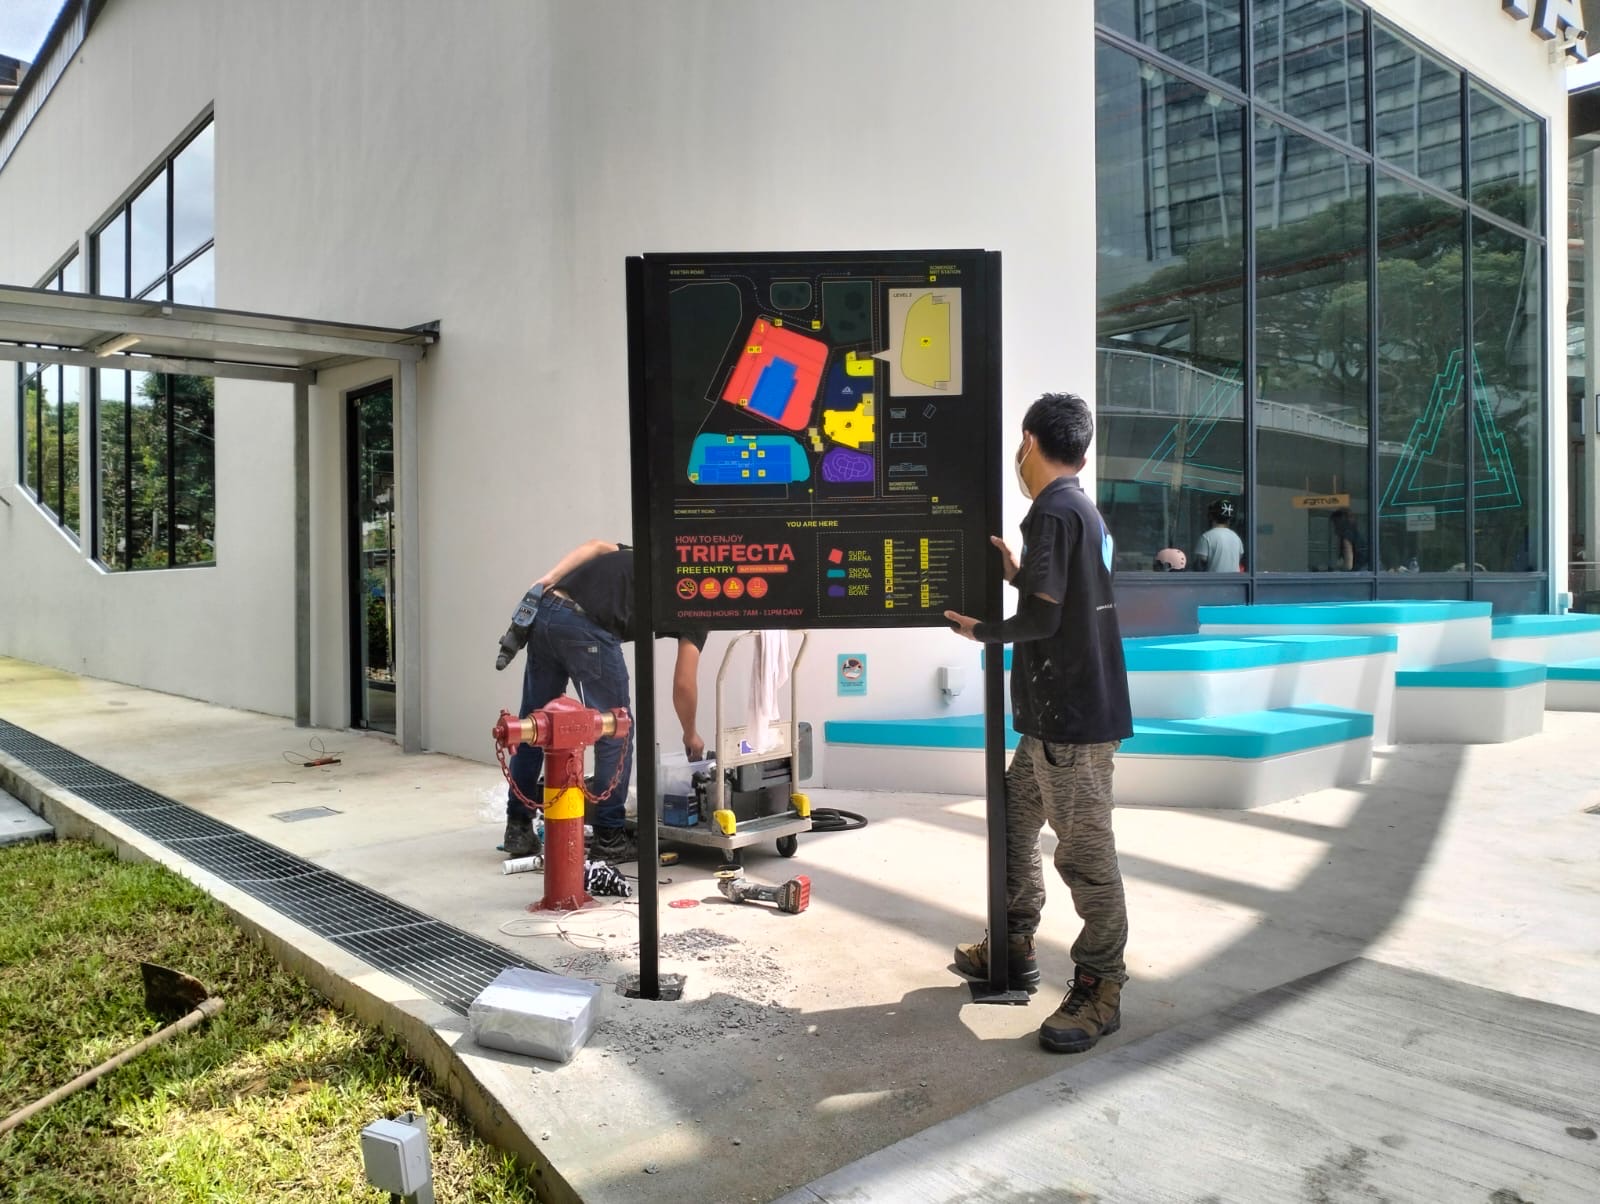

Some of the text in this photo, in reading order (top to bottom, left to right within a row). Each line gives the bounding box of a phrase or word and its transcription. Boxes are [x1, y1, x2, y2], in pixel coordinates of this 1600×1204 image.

[675, 534, 744, 544] HOW TO ENJOY
[675, 543, 796, 563] TRIFECTA
[676, 566, 701, 575] FREE
[703, 565, 735, 574] ENTRY
[677, 609, 712, 618] OPENING
[743, 608, 758, 617] 7AM
[763, 608, 782, 616] 11PM
[783, 608, 804, 616] DAILY
